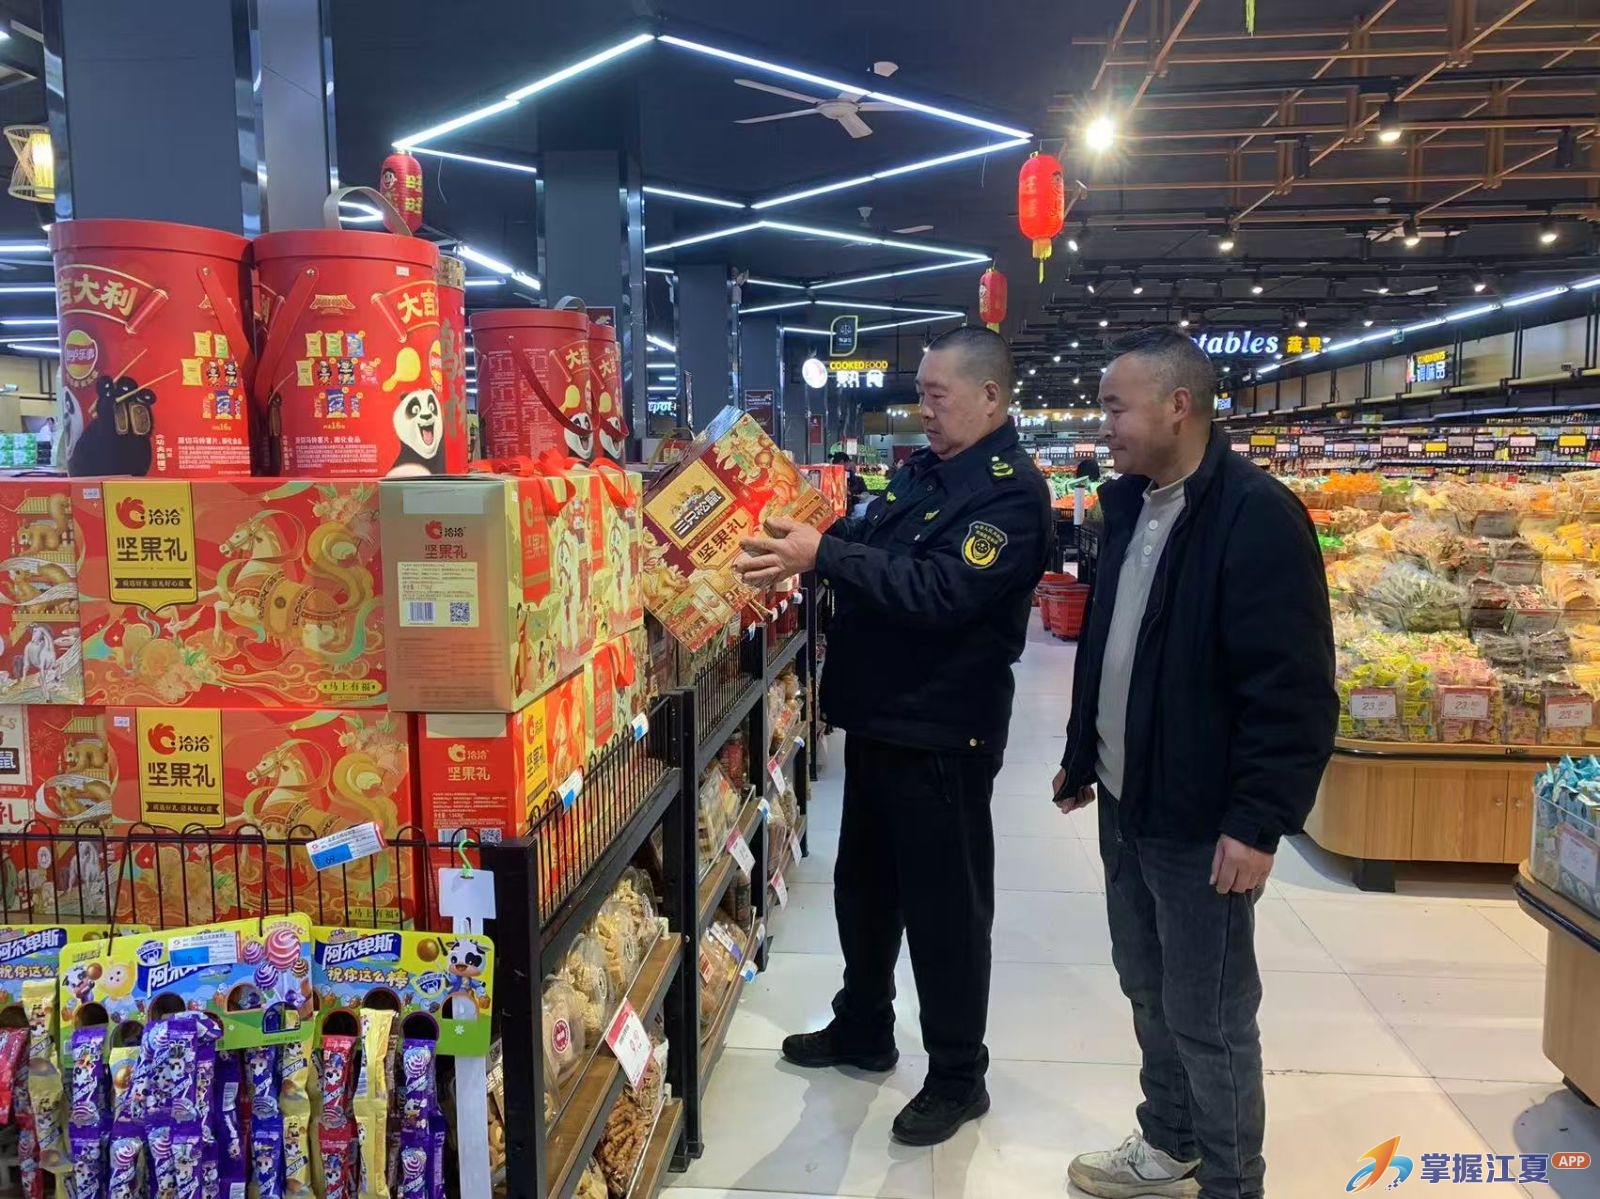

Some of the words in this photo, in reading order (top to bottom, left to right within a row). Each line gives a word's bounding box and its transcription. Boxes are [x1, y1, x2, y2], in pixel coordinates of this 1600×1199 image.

[1190, 330, 1279, 354] tables
[829, 360, 865, 370] COOKED
[865, 360, 888, 369] FOOD
[148, 508, 181, 526] 洽洽
[673, 490, 722, 536] 三只松鼠
[117, 537, 187, 562] 坚果礼
[424, 544, 468, 559] 坚果礼
[696, 518, 747, 564] 坚果礼
[178, 735, 211, 753] 洽洽
[147, 762, 215, 789] 坚果礼
[447, 766, 491, 782] 坚果礼
[321, 933, 394, 970] 阿尔卑斯
[0, 964, 58, 979] 祝你这么
[327, 966, 409, 990] 祝你这么棒
